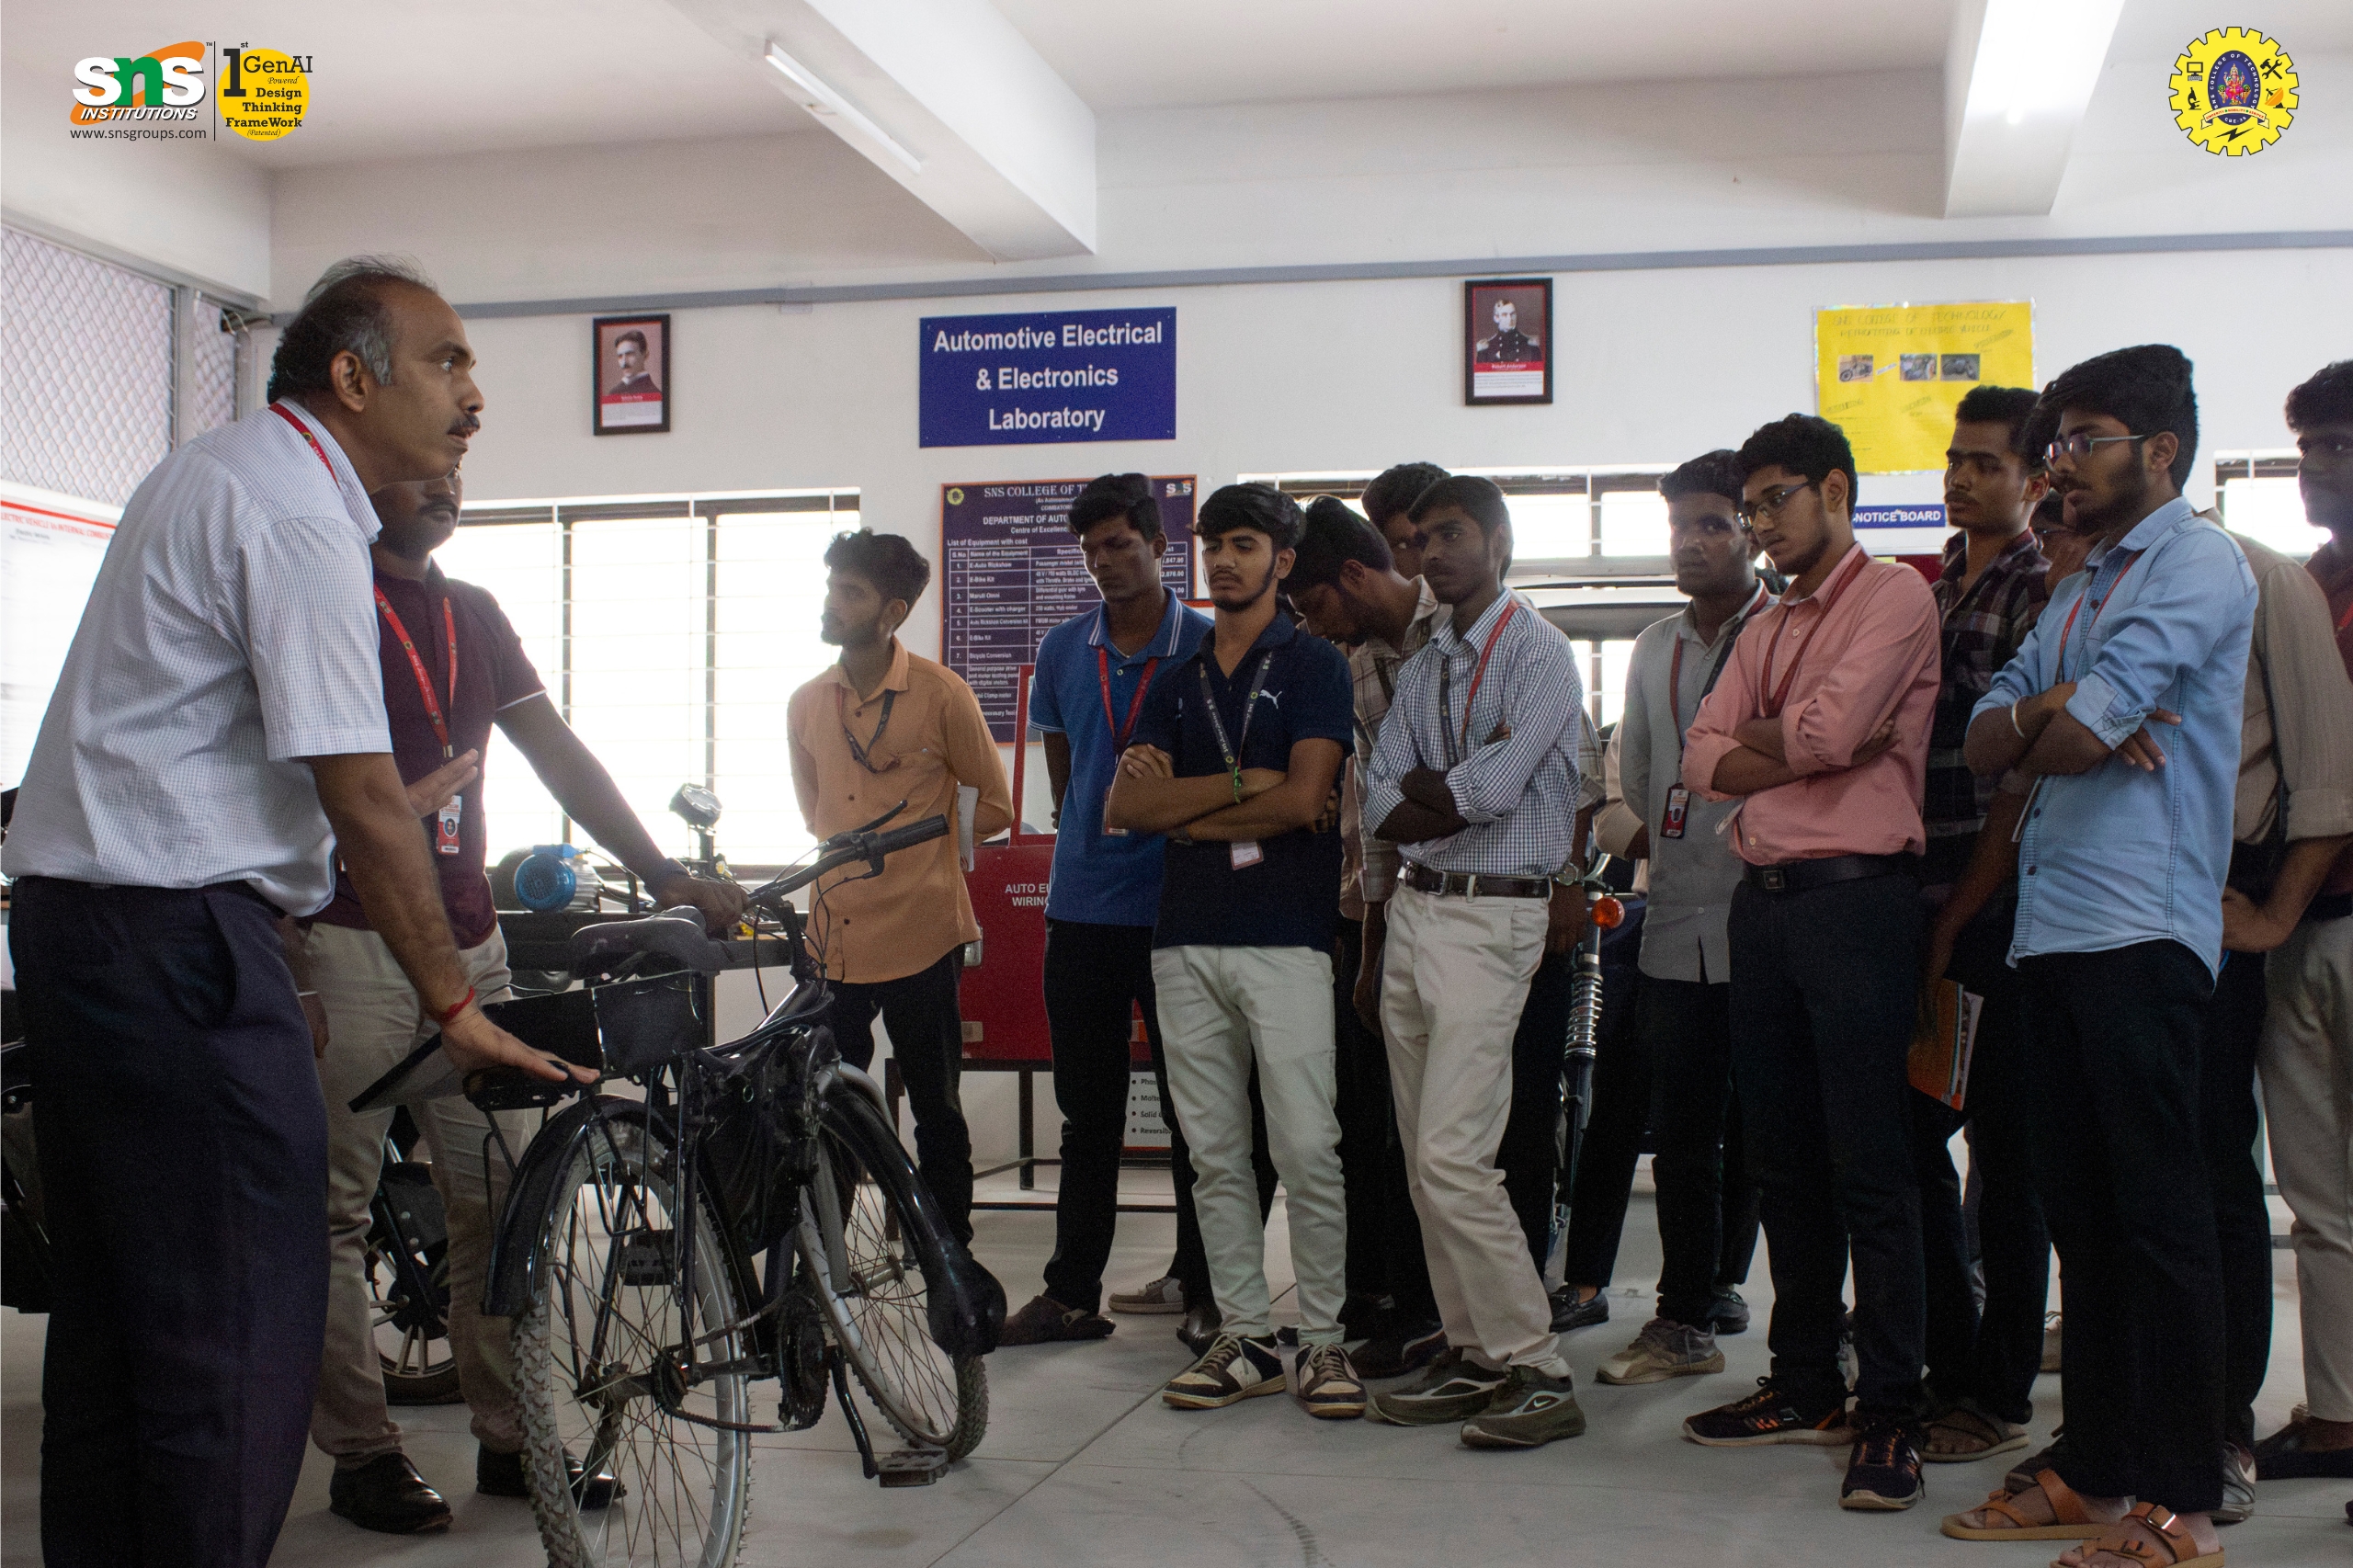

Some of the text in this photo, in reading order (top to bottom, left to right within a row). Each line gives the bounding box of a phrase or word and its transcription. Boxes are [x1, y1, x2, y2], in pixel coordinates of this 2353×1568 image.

[933, 322, 1162, 352] Automotive Electrical
[976, 365, 1119, 391] & Electronics
[989, 407, 1105, 432] Laboratory
[983, 487, 1005, 497] SNS
[1006, 485, 1057, 497] COLLEGE
[1060, 485, 1074, 494] OF
[983, 515, 1035, 525] DEPARTMENT
[1049, 514, 1067, 523] AUTO
[1855, 510, 1941, 523] NOTICE BOARD
[968, 539, 1000, 547] Equipment
[1057, 548, 1082, 556] Specific
[1005, 883, 1036, 893] AUTO
